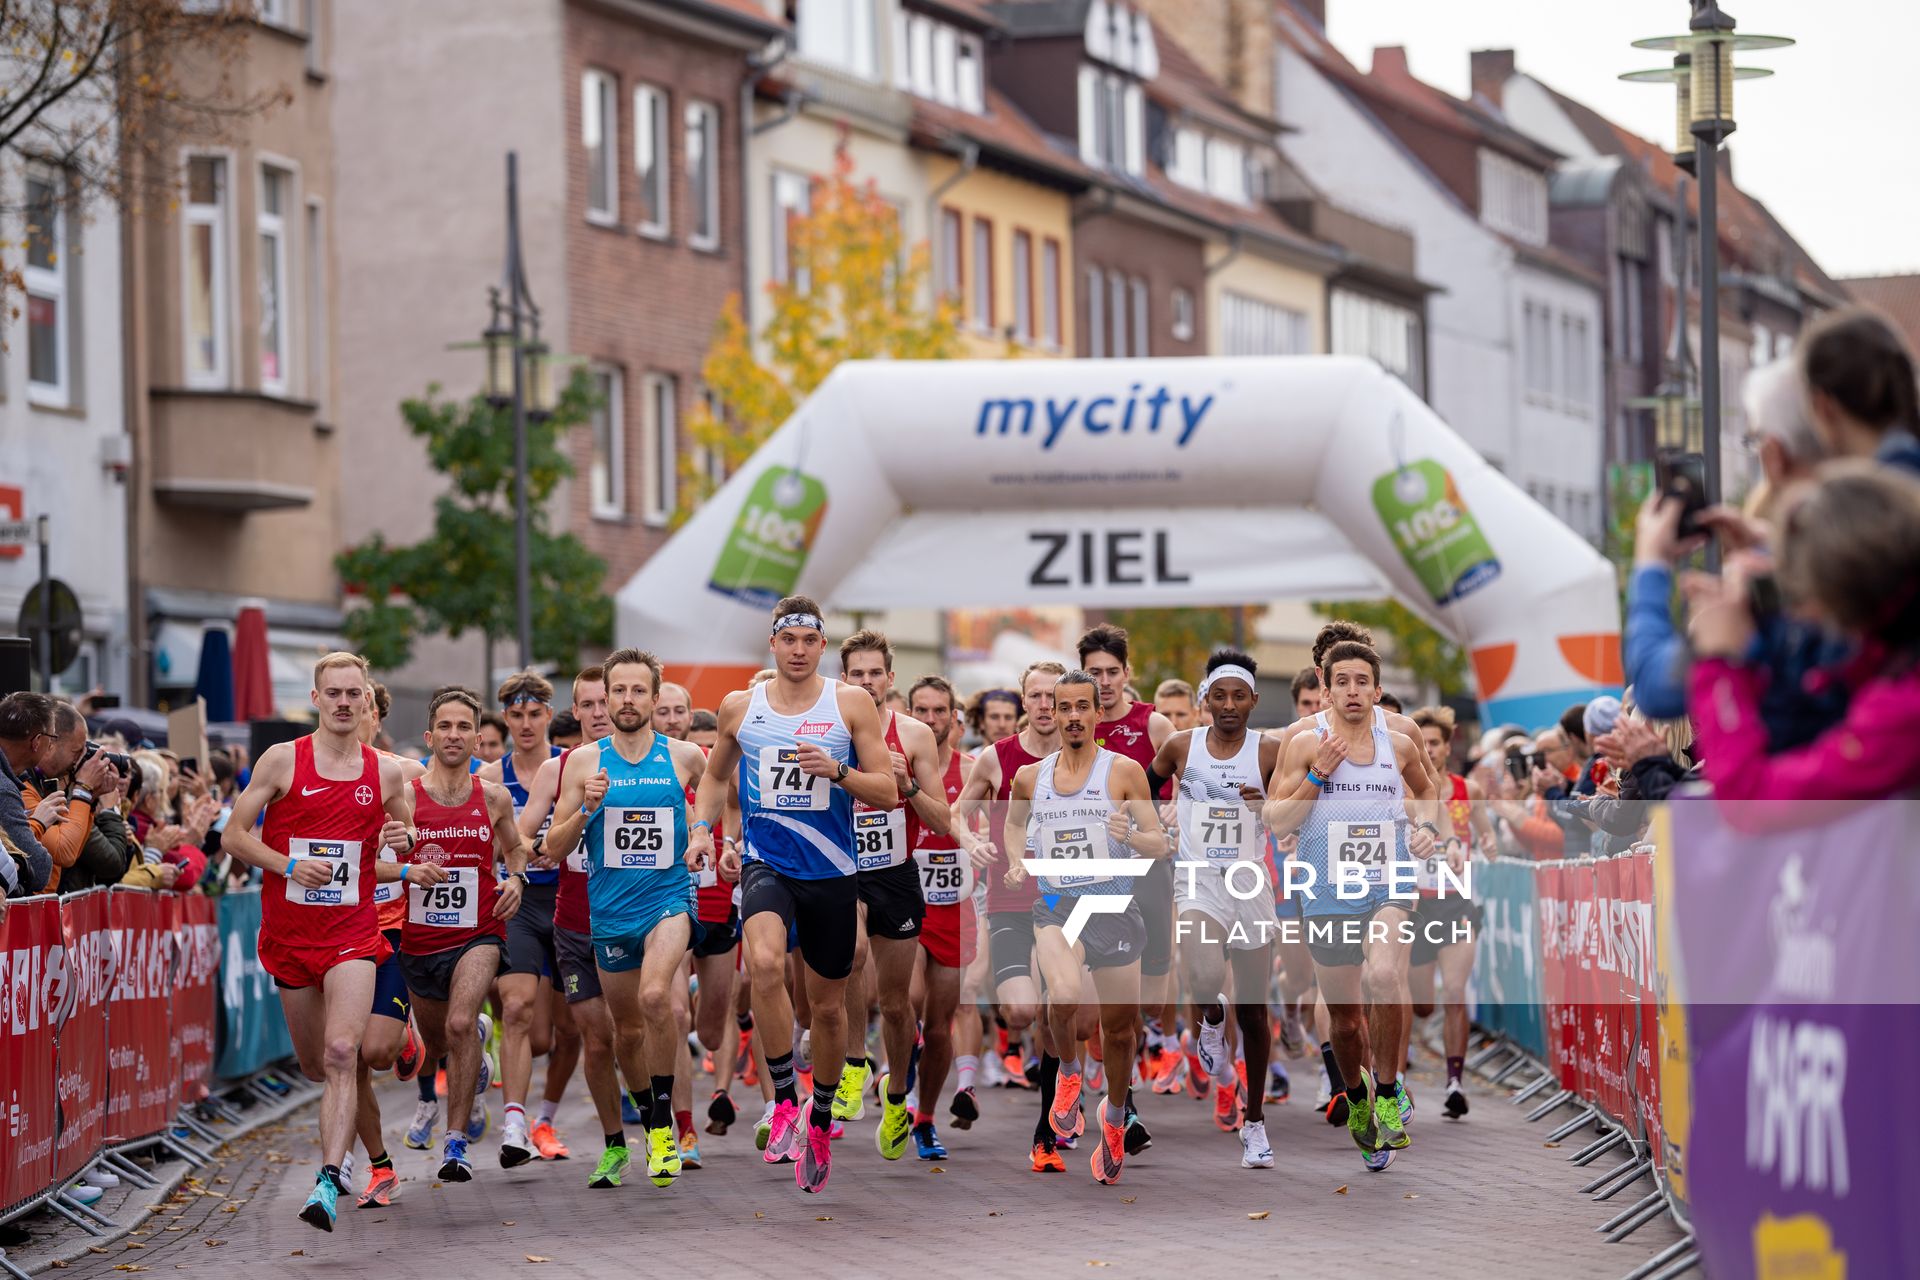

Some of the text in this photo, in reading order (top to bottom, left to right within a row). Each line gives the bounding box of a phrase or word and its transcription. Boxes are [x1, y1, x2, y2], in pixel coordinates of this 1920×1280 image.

[976, 383, 1214, 449] mycity
[1029, 531, 1191, 587] ZIEL
[613, 779, 636, 787] TELIS
[770, 766, 816, 791] 747
[1335, 783, 1396, 795] TELIS FINANZ
[640, 814, 653, 822] GLS
[1044, 808, 1108, 820] TELIS FINANZ
[872, 817, 885, 825] GLS
[1071, 831, 1084, 840] GLS
[1201, 822, 1242, 844] 711
[1365, 828, 1378, 836] GLS
[615, 827, 663, 851] 625
[857, 829, 893, 854] 681
[327, 847, 341, 855] GLS
[1050, 843, 1094, 859] 621
[1339, 842, 1387, 865] 624
[636, 855, 655, 863] PLAN
[872, 855, 890, 864] PLAN
[923, 867, 964, 889] 758
[374, 888, 388, 897] LAN
[420, 886, 467, 910] 759
[440, 913, 458, 921] PLAN
